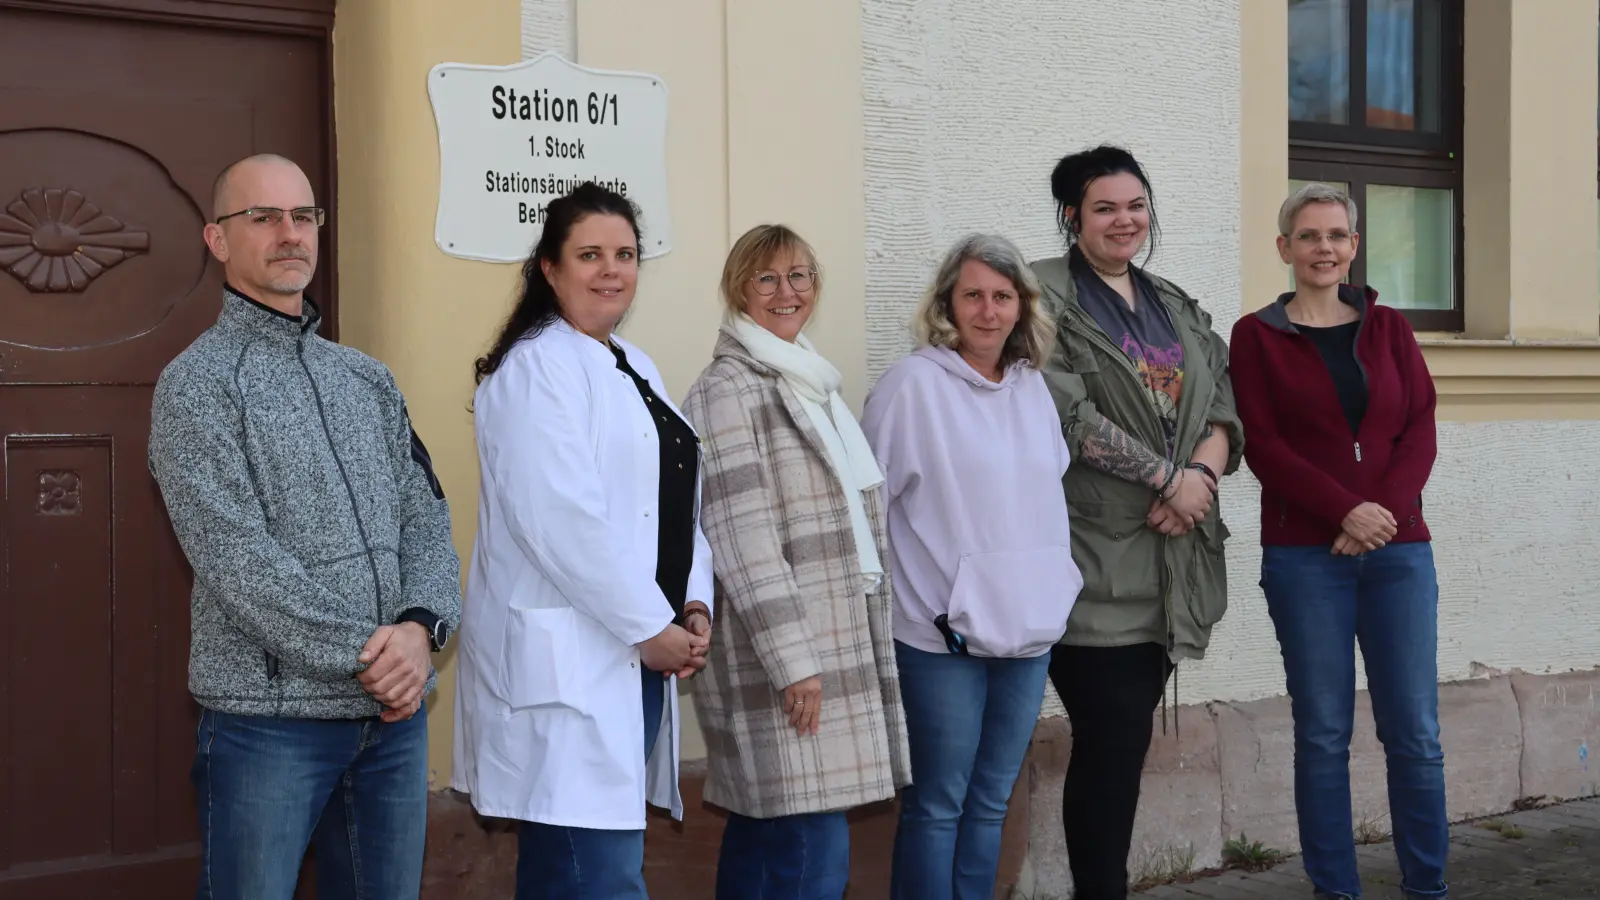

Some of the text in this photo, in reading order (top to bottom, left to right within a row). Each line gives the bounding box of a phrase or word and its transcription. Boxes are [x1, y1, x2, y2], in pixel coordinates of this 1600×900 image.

[492, 85, 618, 126] Station 6/1
[528, 135, 585, 159] 1. Stock
[486, 170, 627, 197] Stationsäquinte
